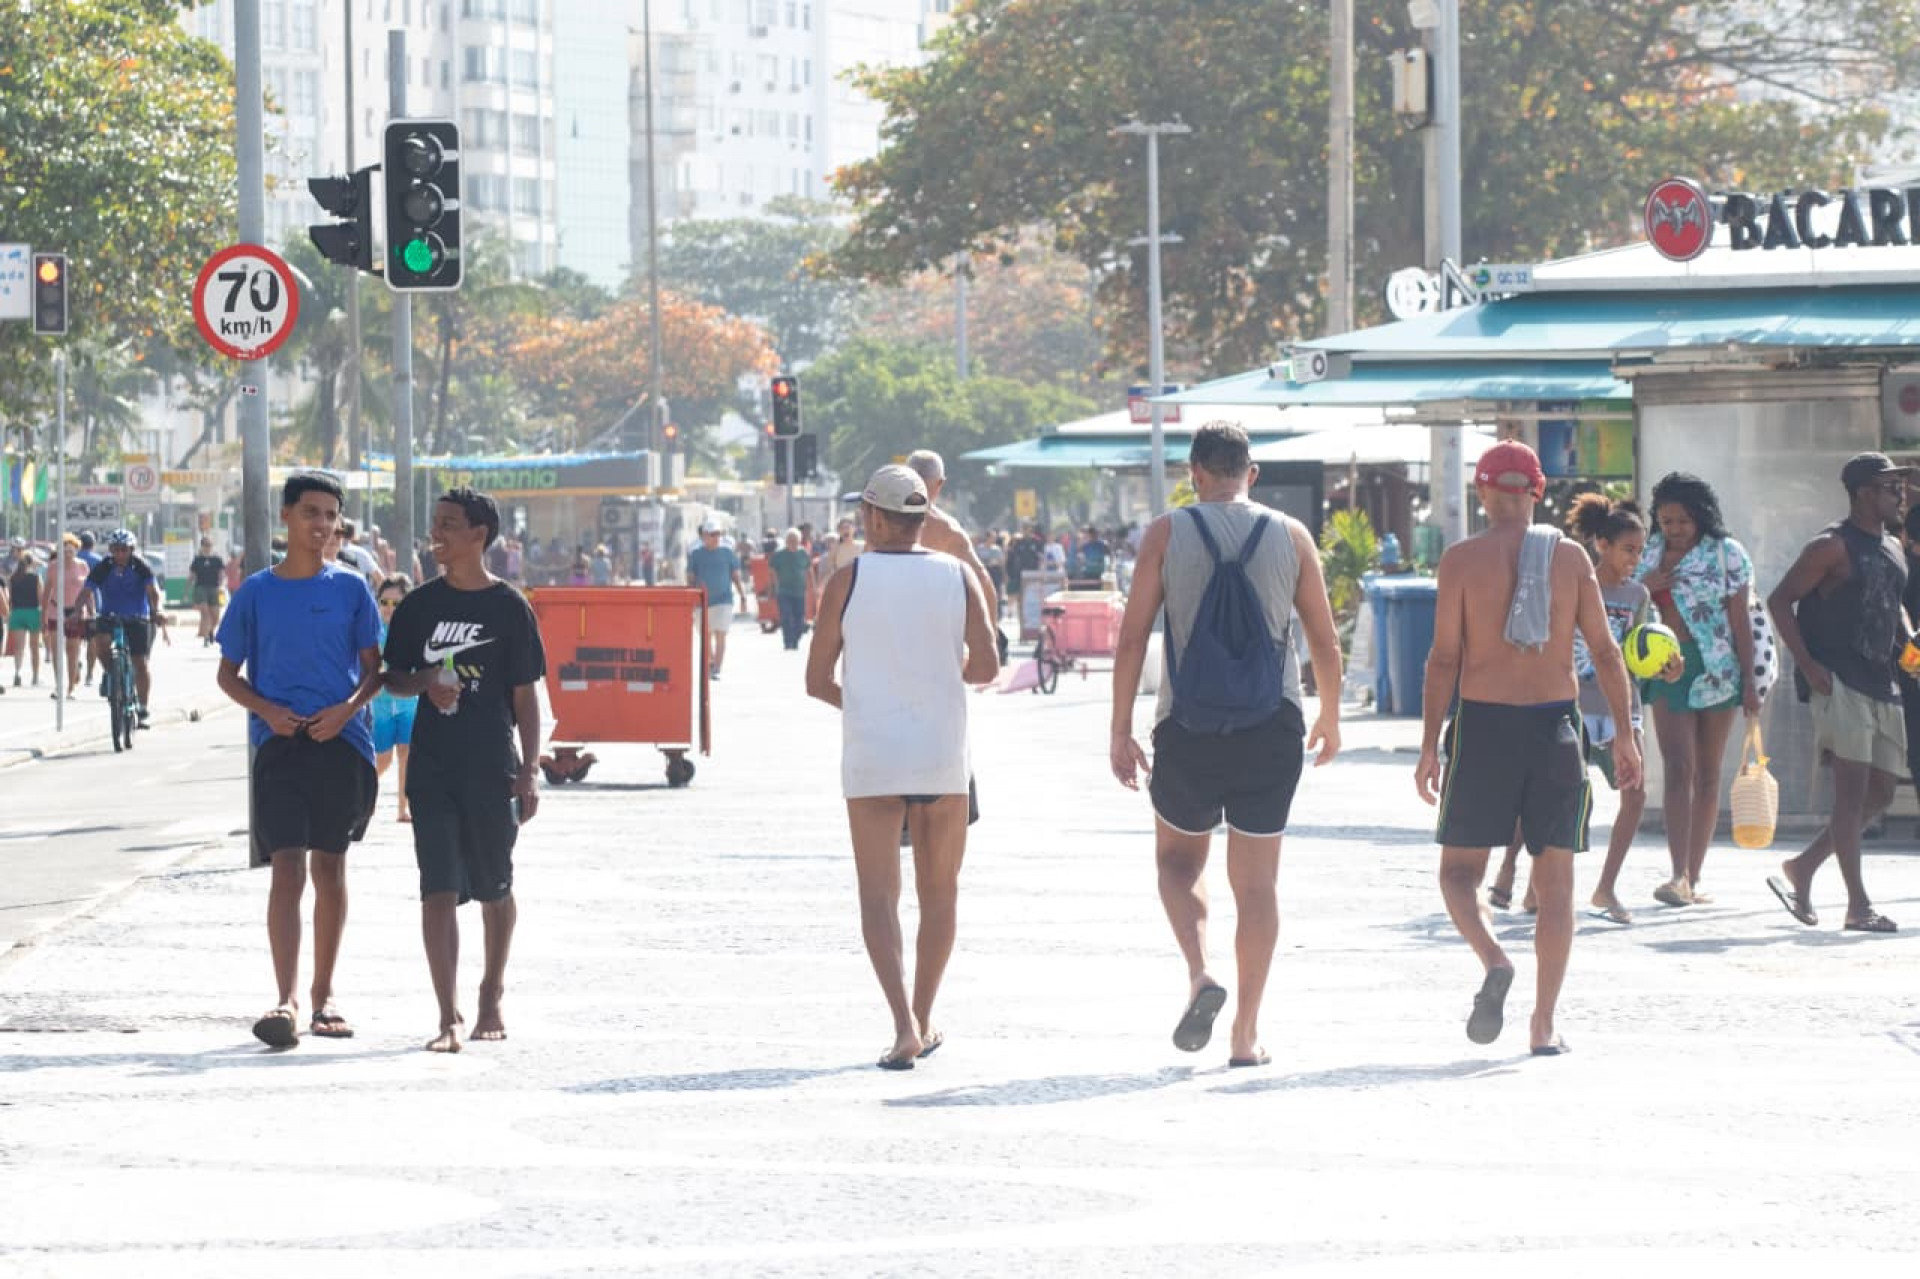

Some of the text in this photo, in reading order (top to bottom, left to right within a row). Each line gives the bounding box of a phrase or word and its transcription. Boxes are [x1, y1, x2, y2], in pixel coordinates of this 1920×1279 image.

[218, 269, 280, 312] 70
[221, 316, 272, 337] km/h
[431, 621, 484, 643] NIKE
